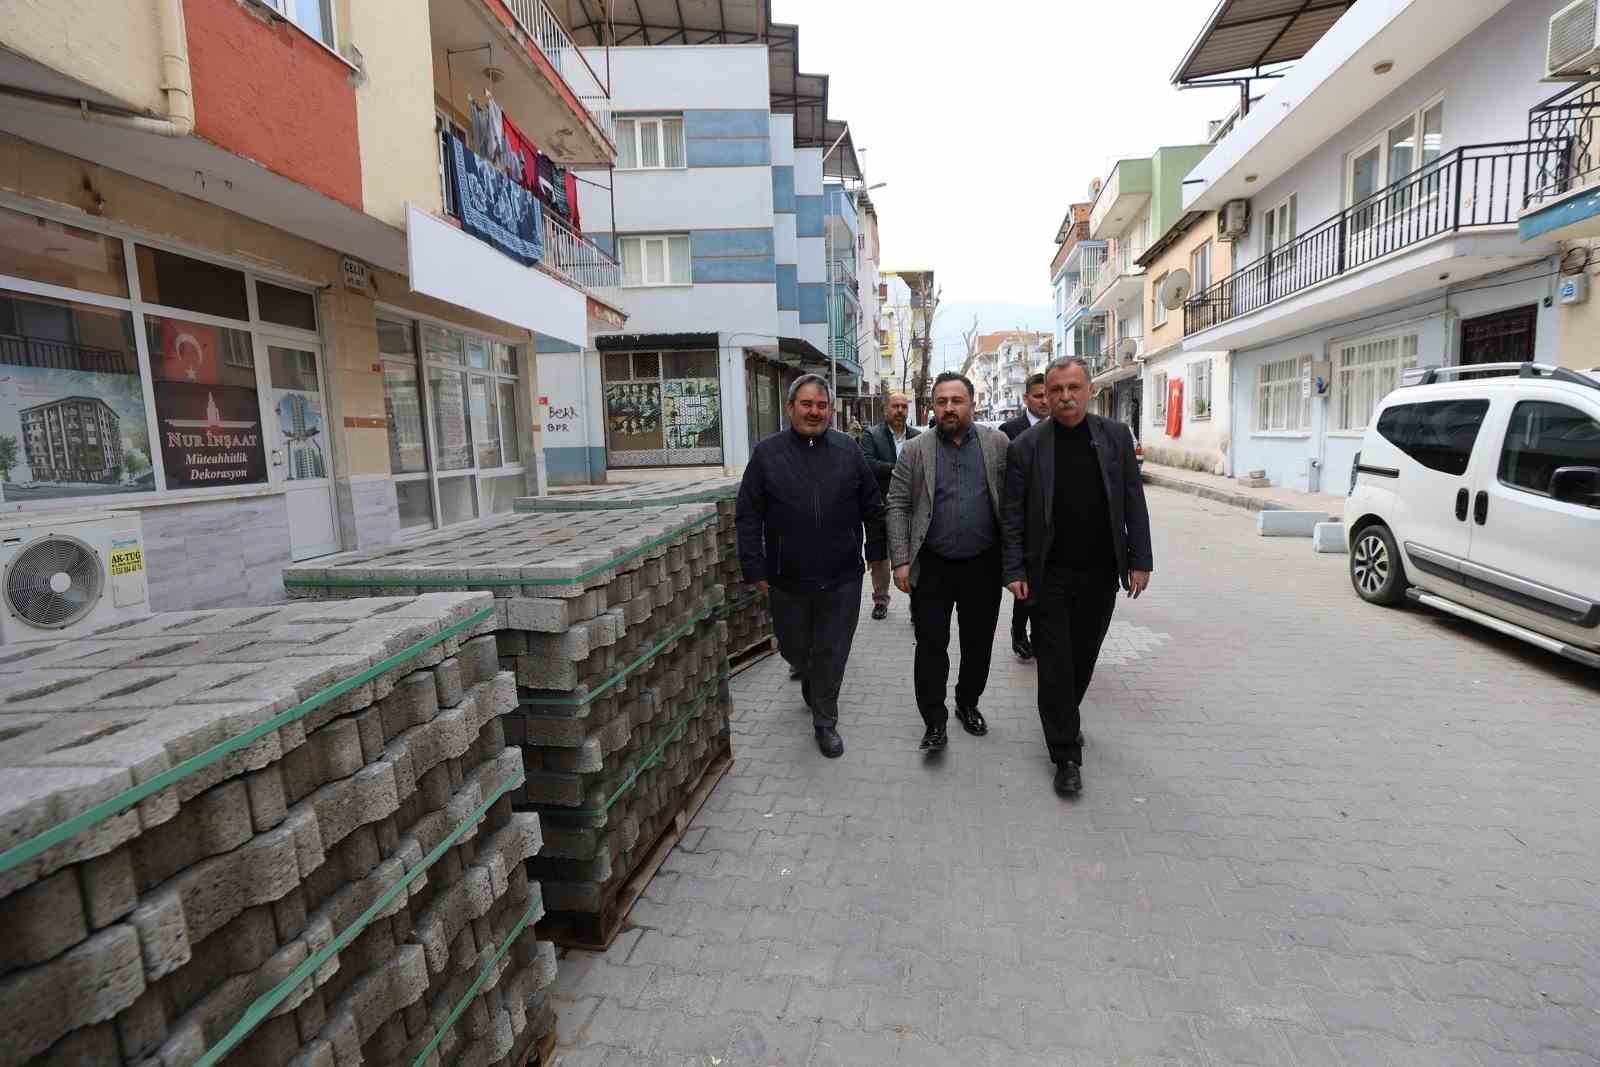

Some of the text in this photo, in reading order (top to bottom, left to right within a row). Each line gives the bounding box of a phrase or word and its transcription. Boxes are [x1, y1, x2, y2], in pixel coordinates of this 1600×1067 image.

[168, 432, 204, 448] NUR
[186, 452, 248, 465] Müteahhitlik
[191, 468, 247, 480] Dekorasyon
